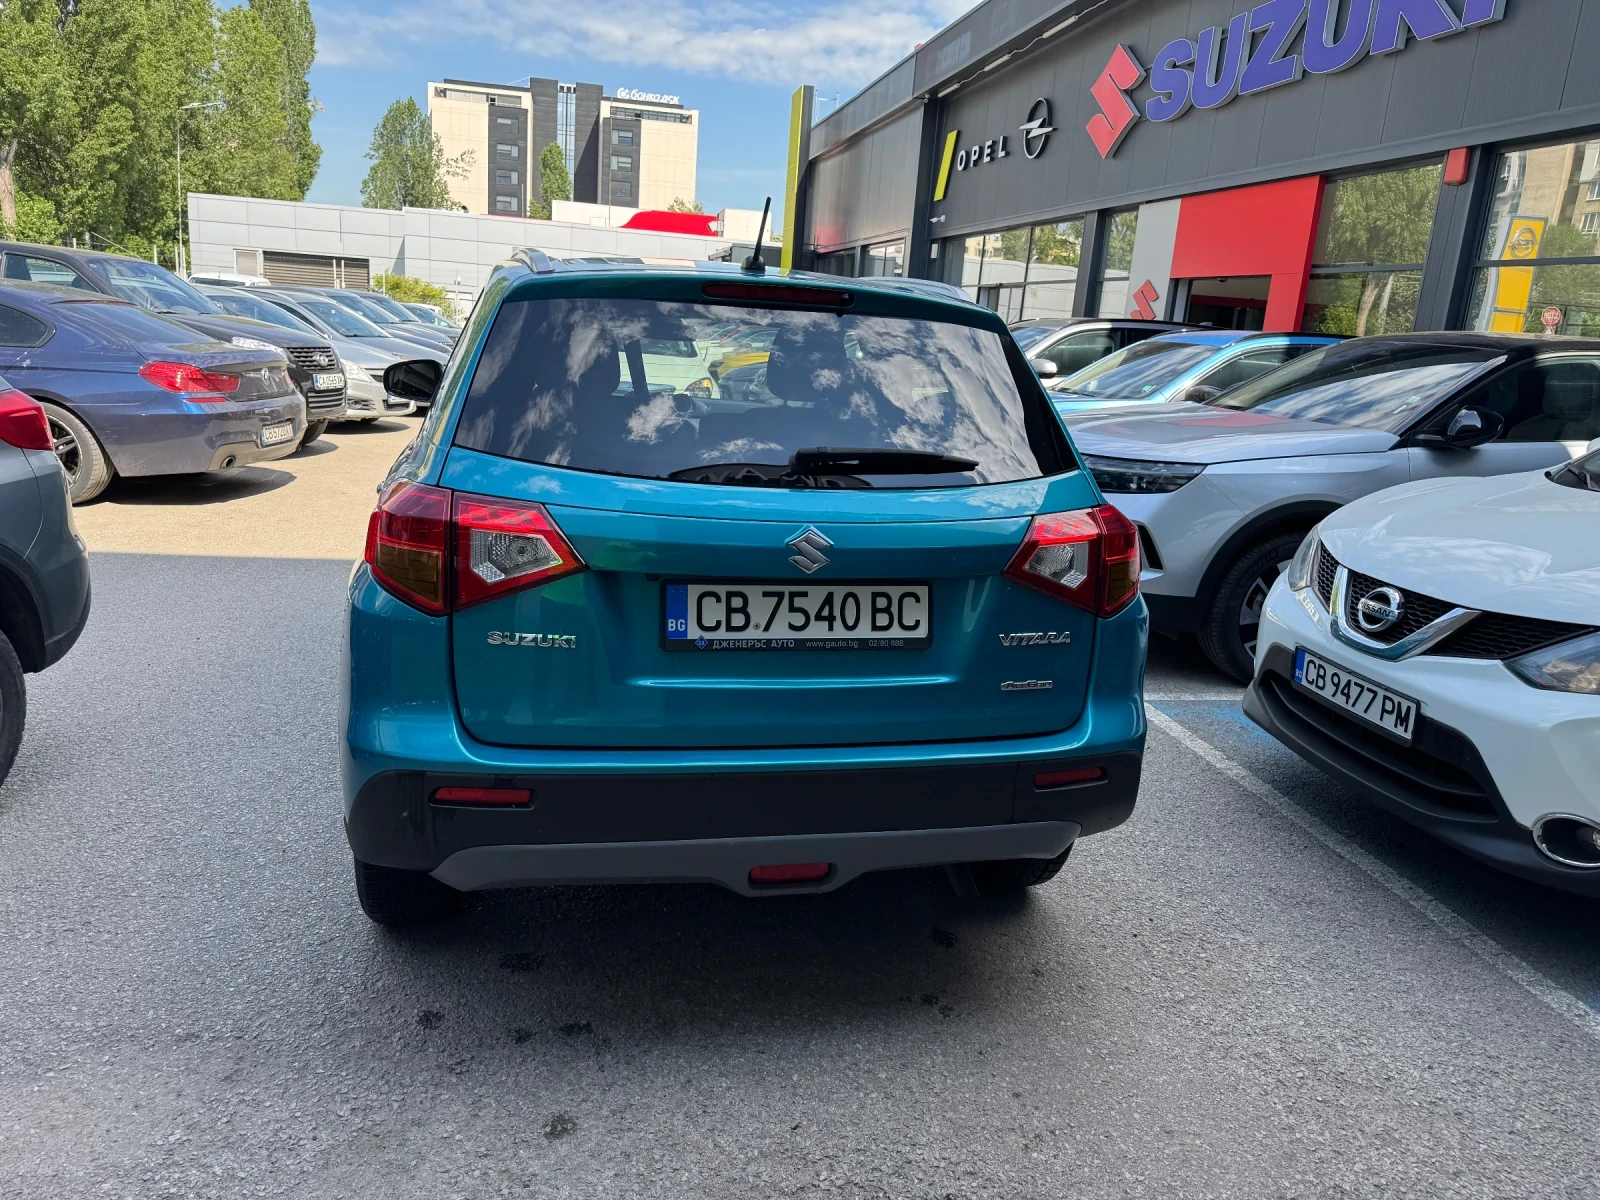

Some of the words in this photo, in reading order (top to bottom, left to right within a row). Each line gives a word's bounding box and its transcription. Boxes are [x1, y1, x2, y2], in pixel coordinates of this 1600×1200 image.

[1145, 0, 1506, 122] SUZU
[957, 135, 1007, 171] OPEL
[696, 590, 751, 632] CB
[762, 590, 861, 632] 7540
[870, 591, 921, 632] BC
[1361, 601, 1390, 618] NISSAN
[667, 618, 686, 632] BG
[487, 630, 577, 648] SUZUKI
[712, 639, 768, 650] ДЖЕНЕРЪС
[771, 639, 795, 648] АУТО
[805, 640, 859, 649] www.gauto.bg
[998, 631, 1071, 646] VITARA
[1305, 659, 1327, 691] CB
[1330, 671, 1378, 714] 9477
[1379, 694, 1412, 733] PM
